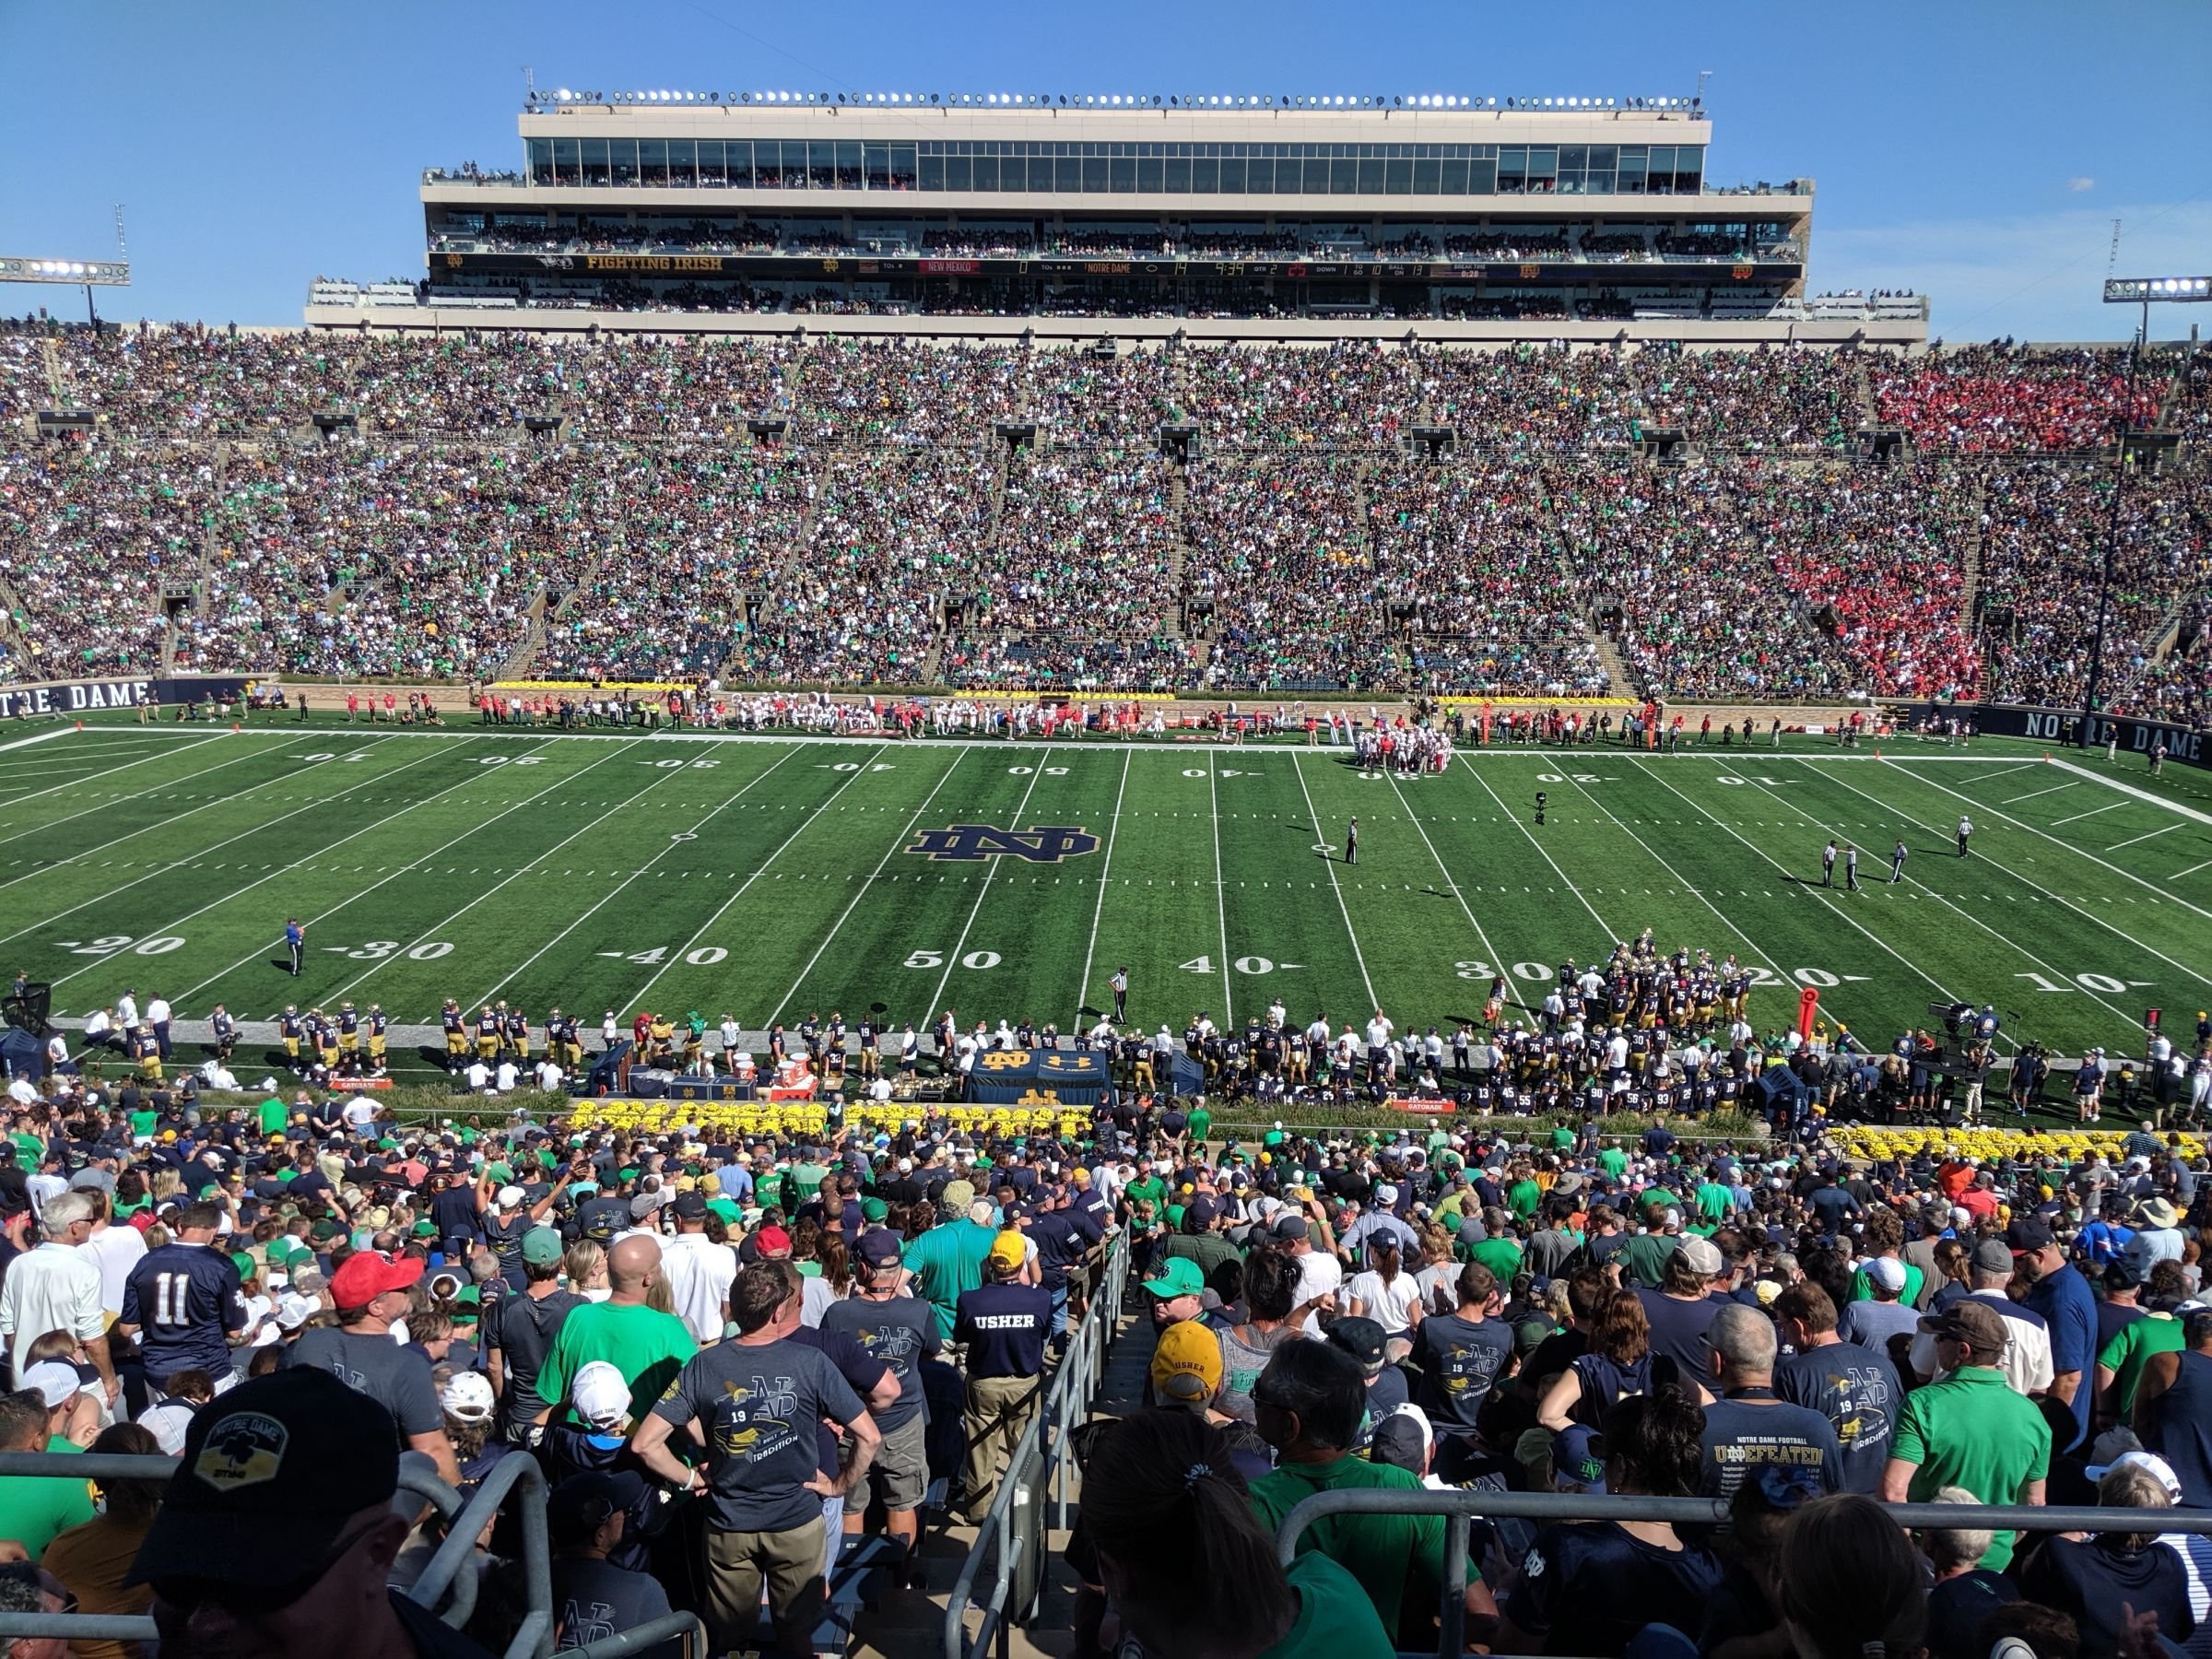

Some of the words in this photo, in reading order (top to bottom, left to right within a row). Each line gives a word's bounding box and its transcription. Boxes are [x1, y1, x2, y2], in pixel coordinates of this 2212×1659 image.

[587, 257, 670, 270] FIGHTING
[674, 258, 724, 271] IRISH
[928, 261, 945, 272] NEW
[946, 262, 971, 273] MEXICO
[1088, 263, 1110, 273] NOTRE
[1112, 264, 1131, 274] DAME
[1174, 262, 1187, 276] 14
[1215, 263, 1244, 276] 9:39
[1270, 265, 1277, 275] 2
[1371, 265, 1382, 276] 10
[1412, 265, 1423, 276] 13
[70, 682, 149, 710] DAME
[71, 936, 186, 955] 20
[347, 941, 455, 960] 30
[627, 946, 729, 966] 40
[903, 950, 1003, 970] 50
[1178, 955, 1275, 975] 40
[1454, 960, 1554, 981] 30
[1699, 971, 1708, 980] 24
[2013, 972, 2127, 994] 10
[1677, 991, 1686, 1000] 15
[1701, 990, 1713, 999] 84
[1568, 998, 1578, 1007] 32
[1618, 999, 1624, 1007] 7
[482, 1020, 494, 1030] 60
[861, 1028, 869, 1037] 19
[1187, 1032, 1196, 1041] 27
[1657, 1030, 1666, 1040] 31
[1291, 1035, 1302, 1045] 35
[1499, 1034, 1509, 1045] 75
[1633, 1035, 1644, 1045] 30
[145, 1040, 156, 1051] 39
[1228, 1044, 1238, 1053] 47
[1530, 1043, 1540, 1053] 76
[830, 1053, 841, 1063] 32
[1137, 1049, 1147, 1059] 46
[1479, 1088, 1489, 1098] 13
[1502, 1088, 1514, 1098] 45
[1591, 1088, 1603, 1098] 90
[1627, 1093, 1638, 1103] 56
[1283, 1095, 1293, 1105] 14
[1519, 1095, 1531, 1105] 55
[1657, 1094, 1669, 1104] 93
[1088, 1199, 1104, 1212] USHER
[156, 1272, 190, 1325] 11
[975, 1314, 1034, 1329] USHER
[1174, 1361, 1205, 1373] USHER
[1453, 1364, 1464, 1372] 19
[1461, 1385, 1491, 1401] TRADITION
[1840, 1399, 1853, 1414] 19
[731, 1410, 747, 1423] 19
[763, 1434, 778, 1444] BUILT
[1363, 1434, 1373, 1445] 19
[1856, 1425, 1889, 1451] TRADITION
[753, 1434, 798, 1462] TRADITION
